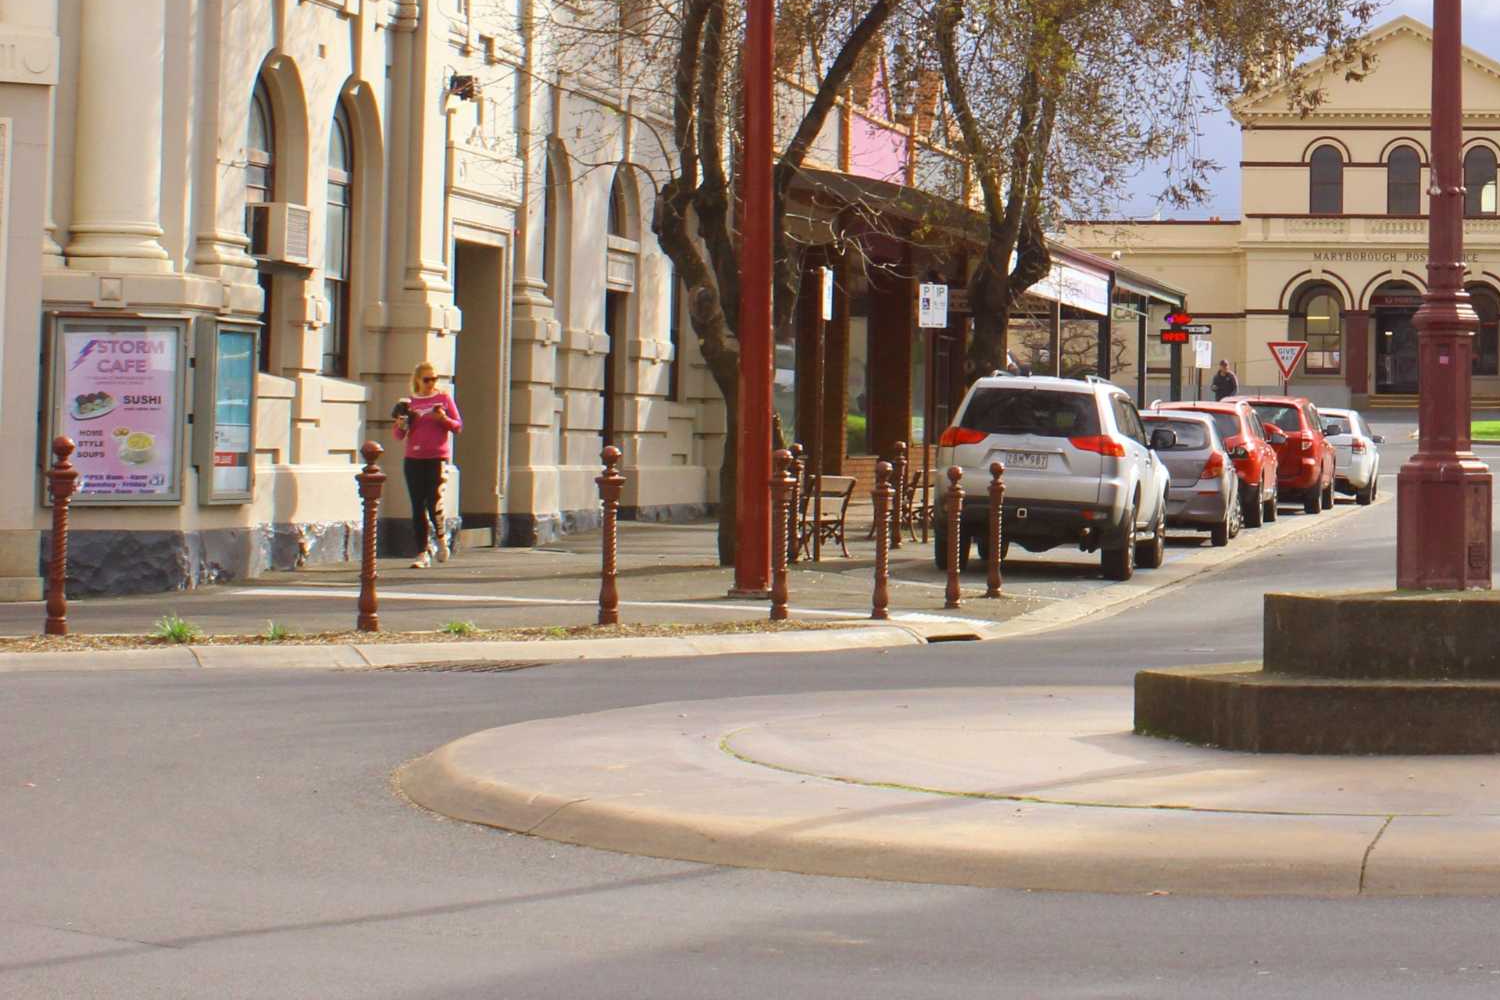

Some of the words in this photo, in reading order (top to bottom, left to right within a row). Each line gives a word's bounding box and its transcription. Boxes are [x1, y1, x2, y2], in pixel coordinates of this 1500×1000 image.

[1313, 252, 1397, 262] MARYBOROUGH
[1406, 252, 1428, 262] POS
[1462, 253, 1479, 262] ICE
[97, 339, 165, 355] STORM
[1277, 347, 1297, 355] GIVE
[97, 359, 147, 373] CAFE
[122, 395, 162, 405] SUSHI
[79, 429, 104, 437] HOME
[78, 440, 103, 448] STYLE
[77, 450, 105, 458] SOUPS
